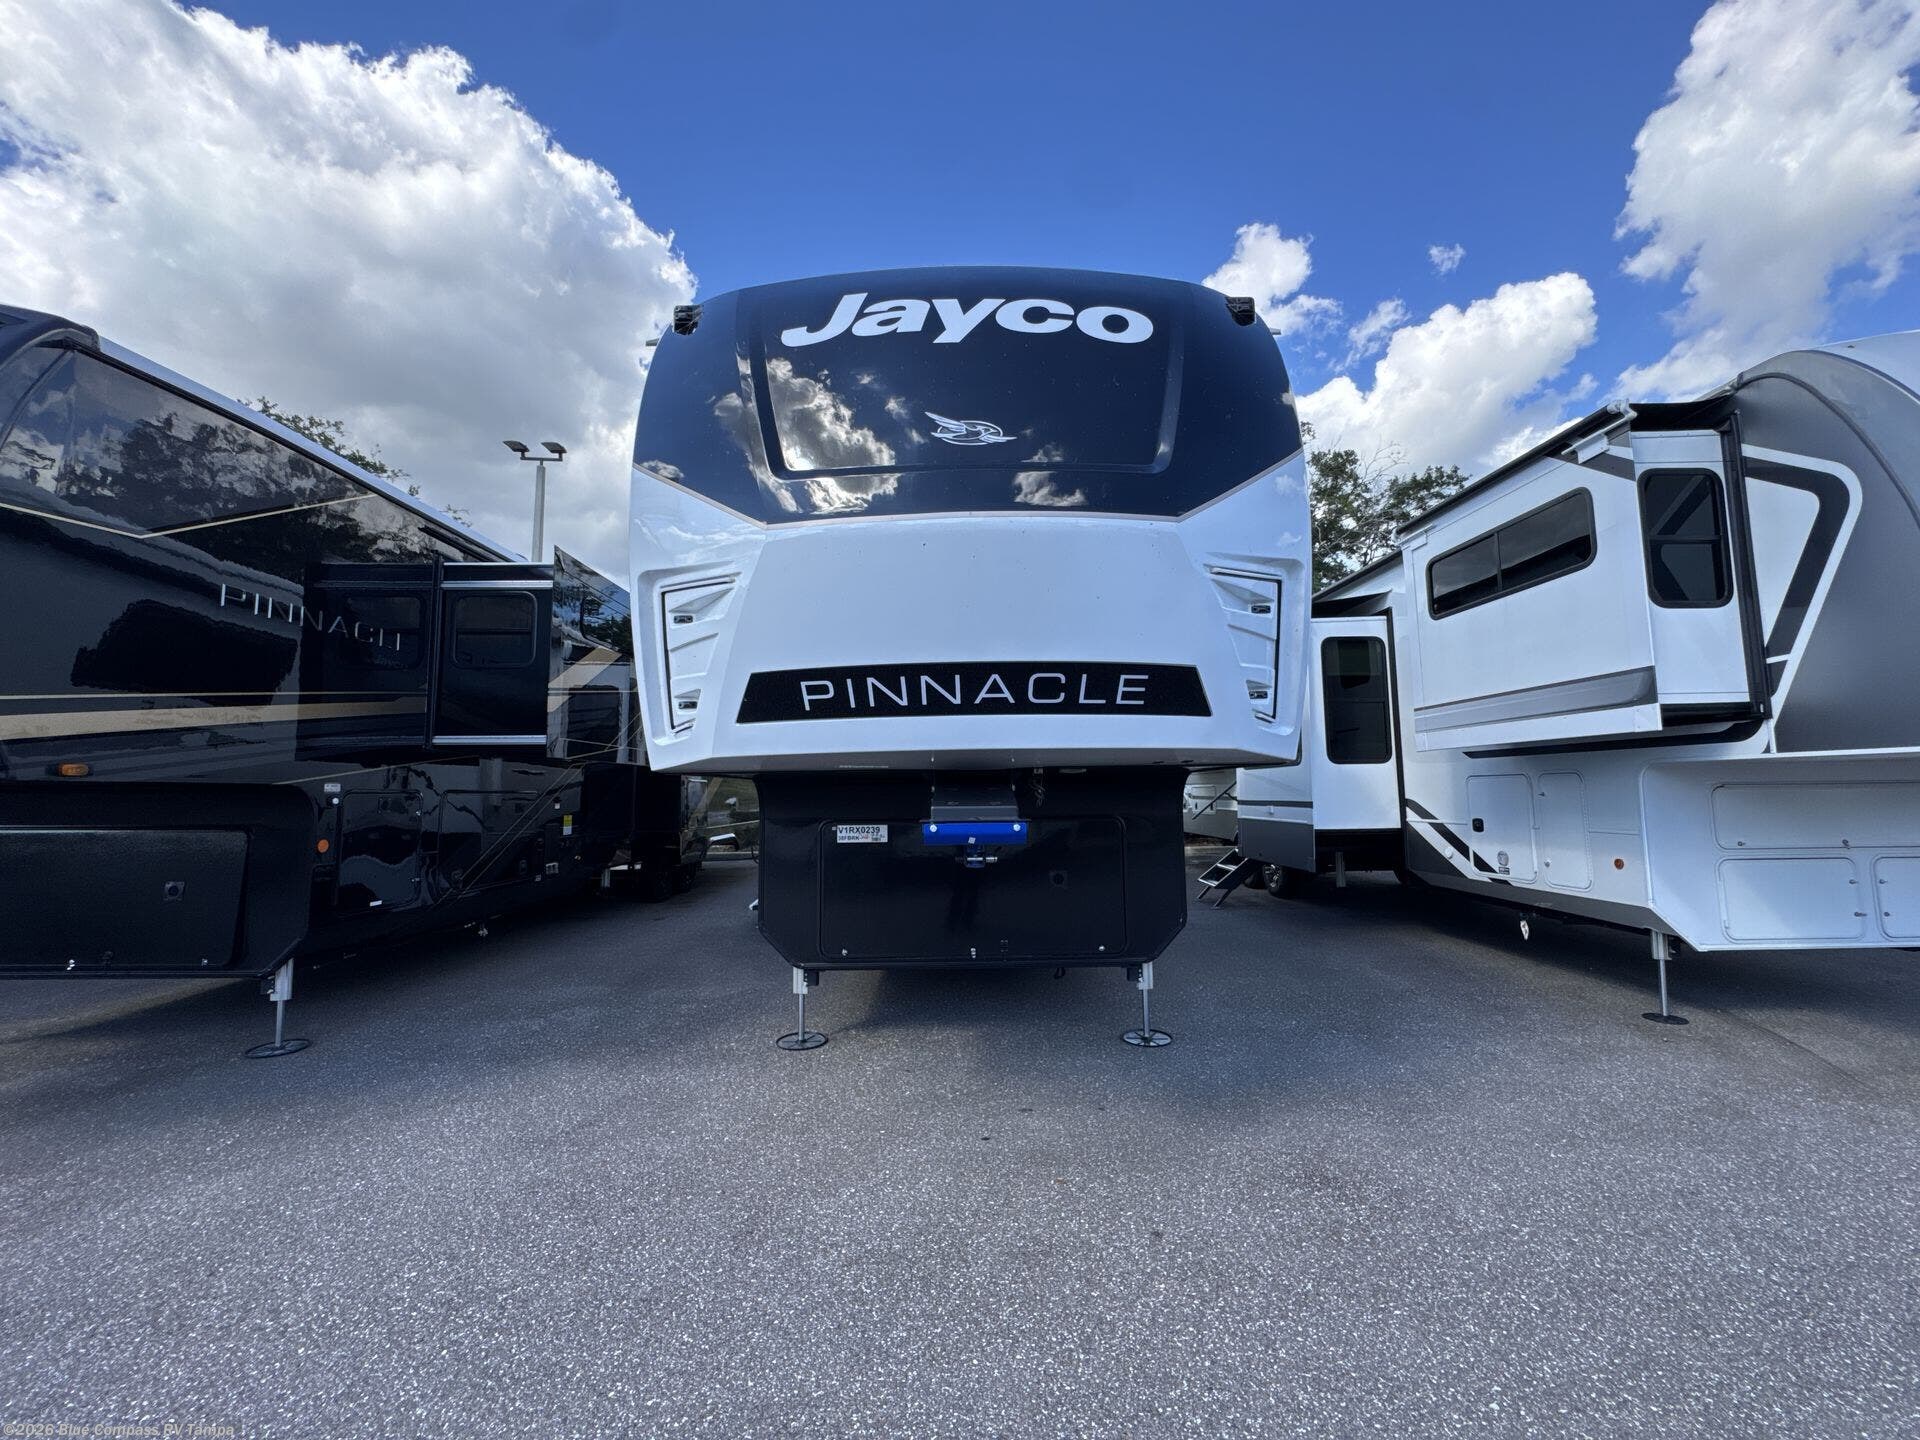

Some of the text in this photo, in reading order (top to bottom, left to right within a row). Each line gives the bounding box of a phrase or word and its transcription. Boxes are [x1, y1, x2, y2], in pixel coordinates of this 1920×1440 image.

[780, 292, 1154, 347] Jayco
[800, 673, 1149, 711] PINNACLE
[838, 826, 880, 834] V1RX0239
